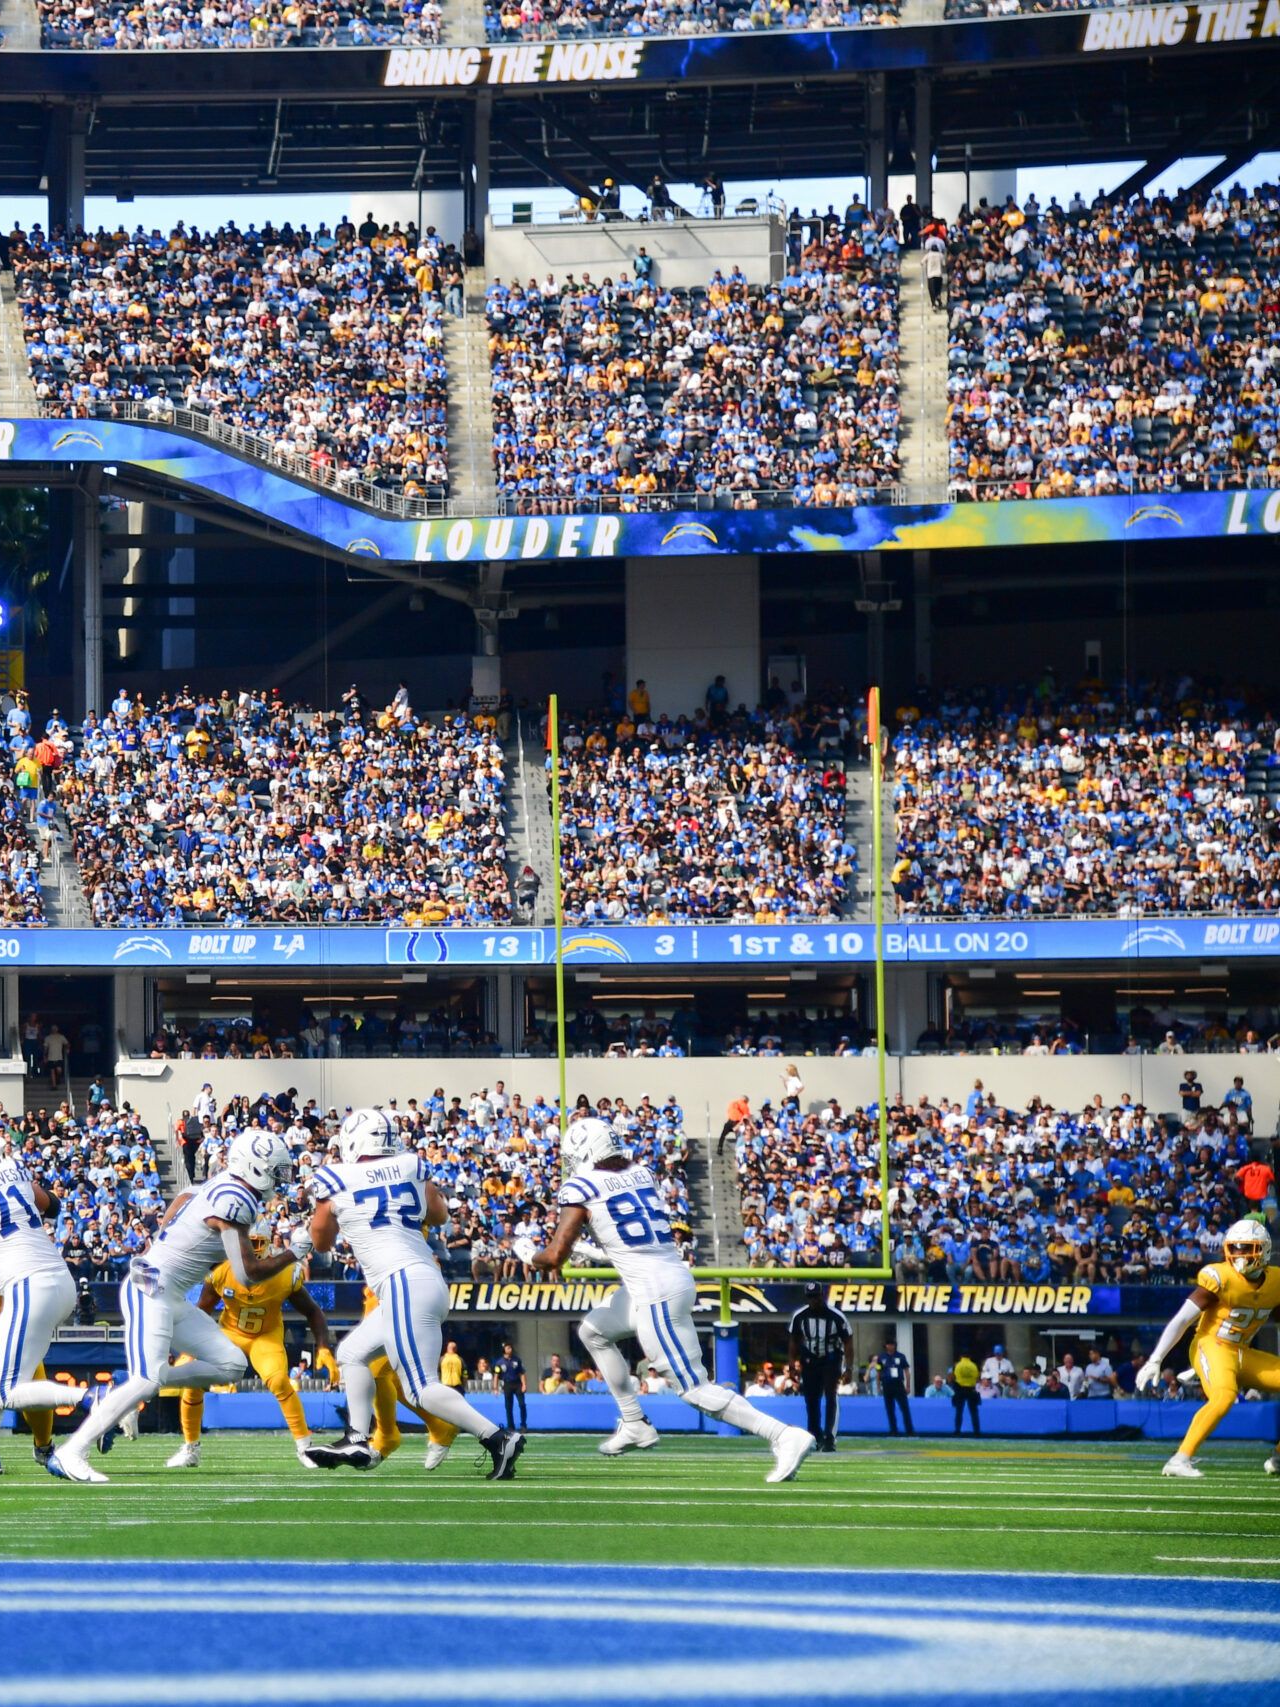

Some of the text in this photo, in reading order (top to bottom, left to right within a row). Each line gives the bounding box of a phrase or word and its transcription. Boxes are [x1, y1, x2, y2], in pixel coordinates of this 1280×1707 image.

[1083, 5, 1189, 51] BRING
[1196, 1, 1261, 44] THE
[384, 41, 644, 87] BRING THE NOISE
[414, 515, 621, 562] LOUDER
[188, 934, 257, 955] BOLT UP
[654, 935, 676, 956] 3
[728, 932, 863, 955] 1ST & 10
[886, 931, 1029, 954] BALL ON 20
[1203, 923, 1280, 945] BOLT UP
[272, 934, 306, 960] LA
[482, 936, 520, 957] 13
[364, 1164, 402, 1184] SMITH
[225, 1203, 241, 1223] 11
[352, 1181, 426, 1232] 72
[605, 1187, 675, 1249] 85
[827, 1284, 1093, 1314] FEEL THE THUNDER
[237, 1306, 267, 1335] 6
